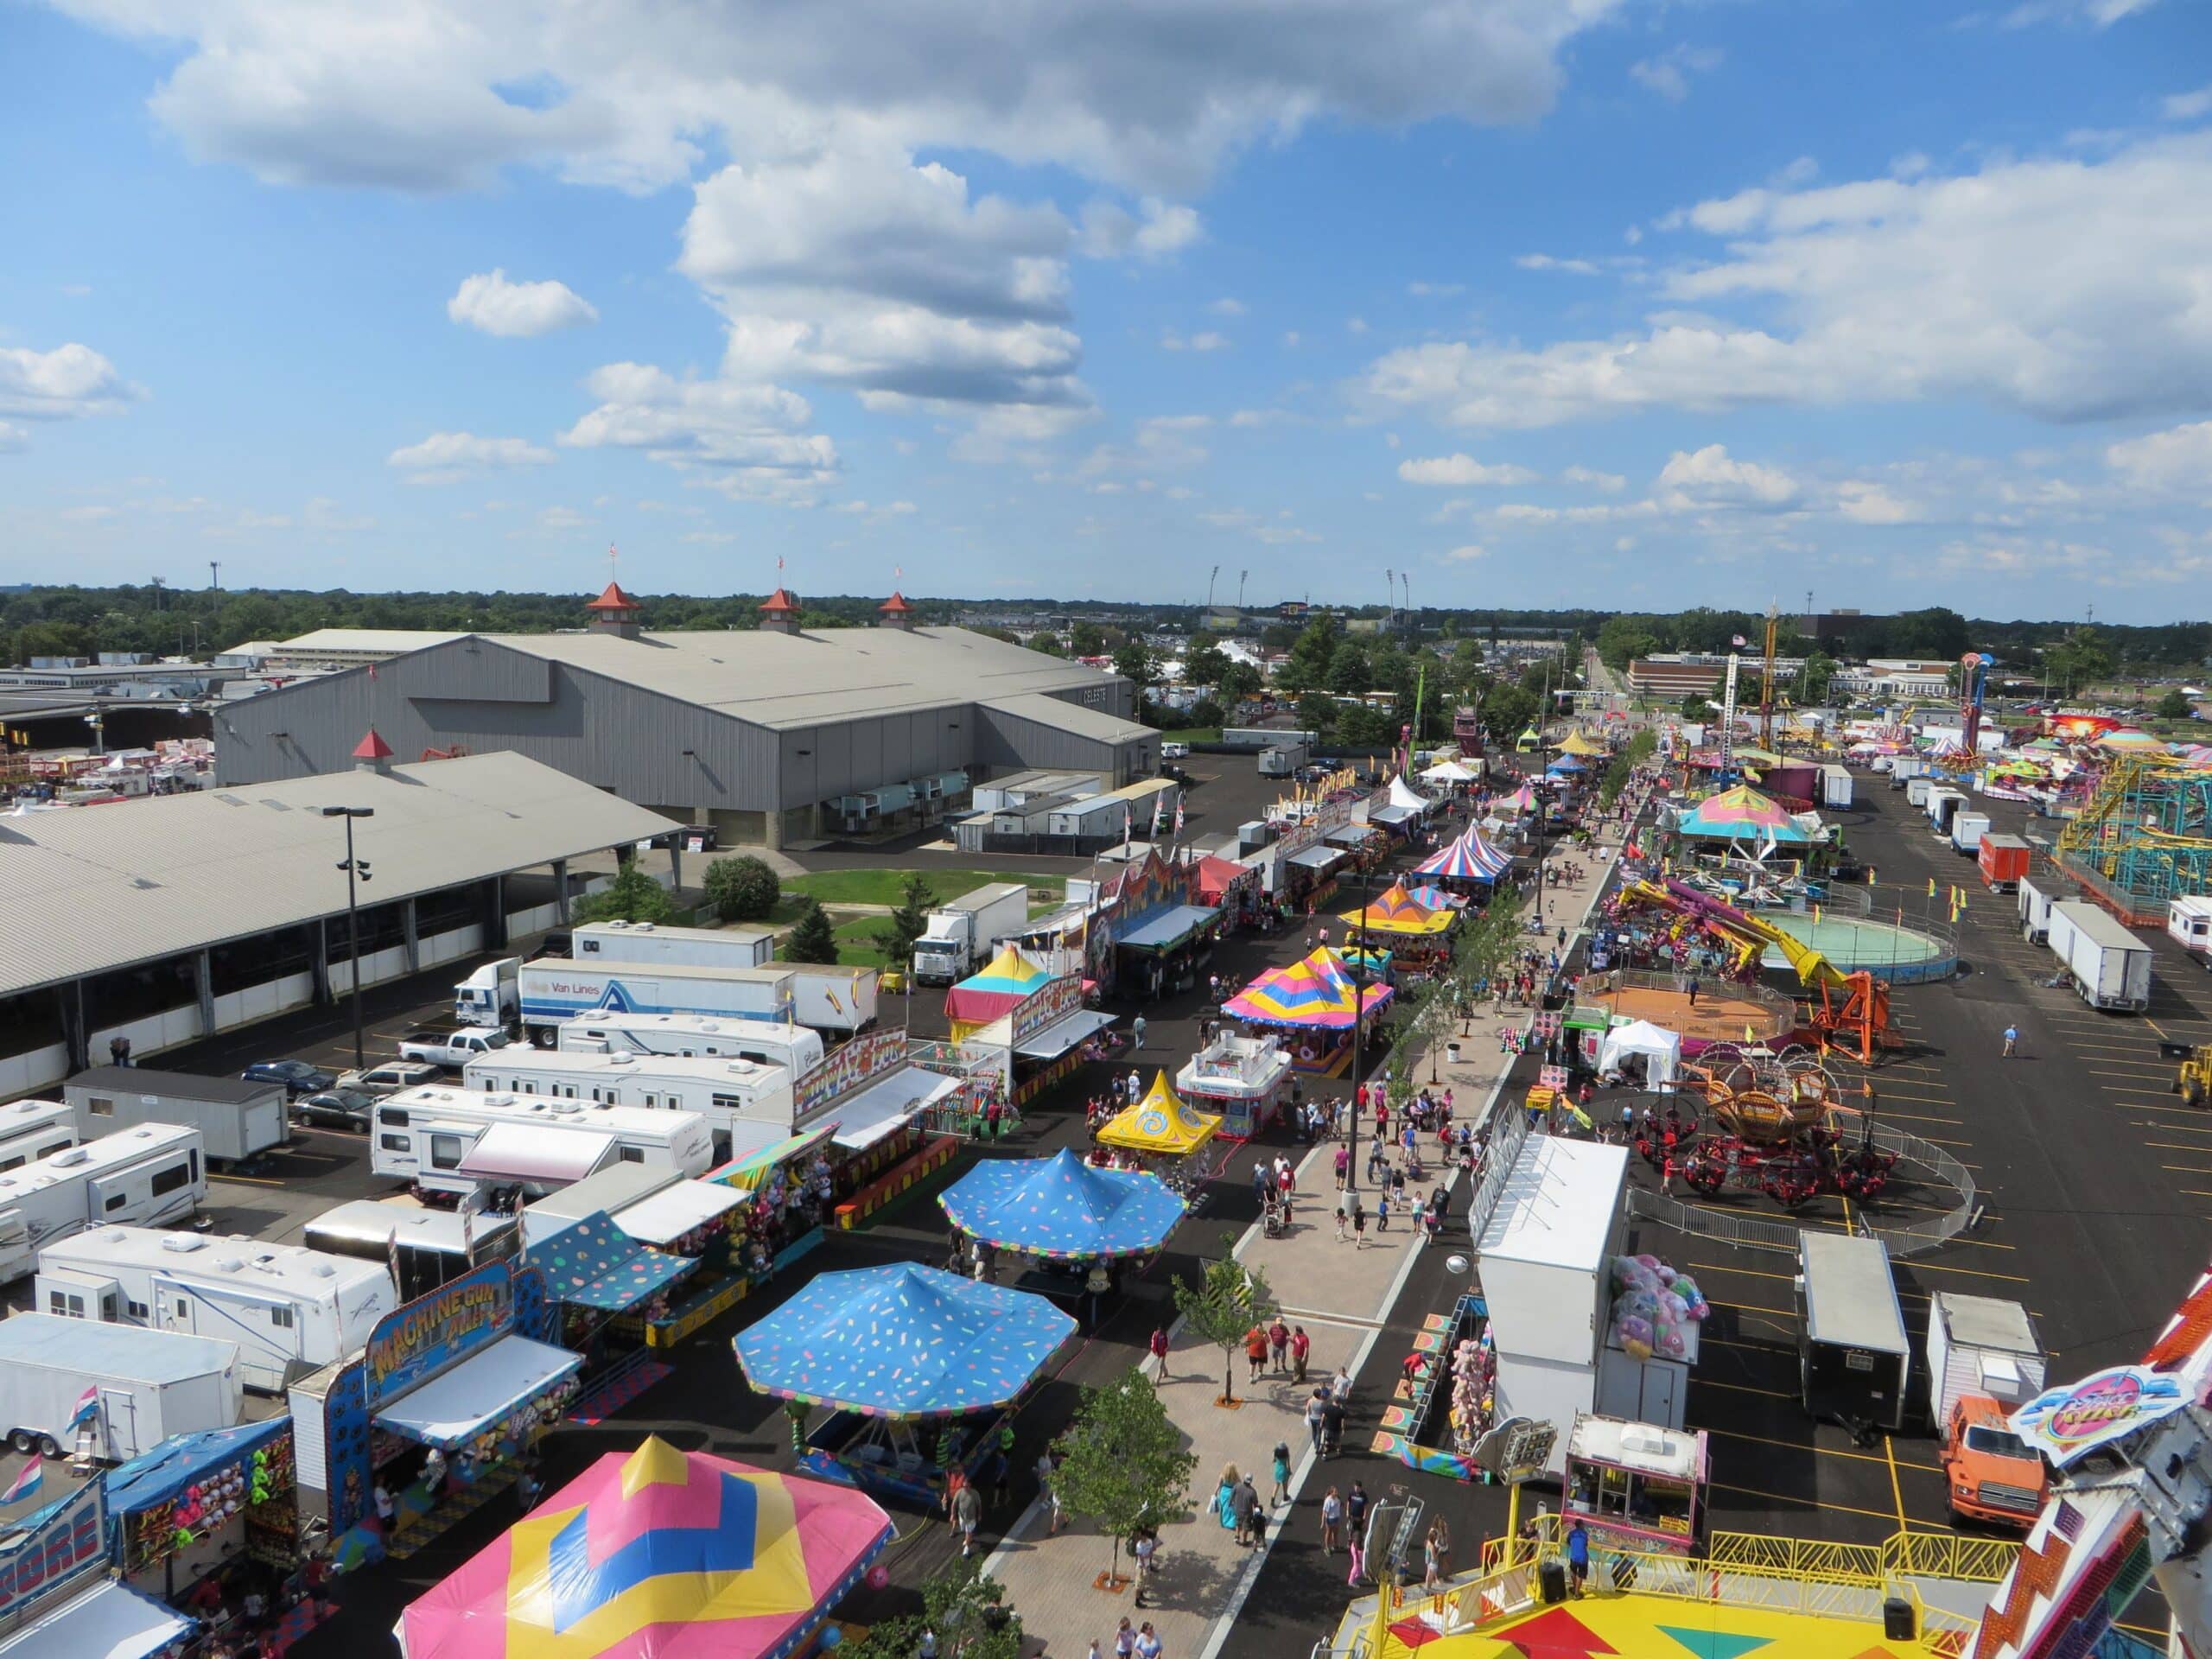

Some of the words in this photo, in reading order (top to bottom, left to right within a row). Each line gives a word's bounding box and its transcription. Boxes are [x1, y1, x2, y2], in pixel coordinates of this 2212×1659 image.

[1084, 687, 1106, 704] CELESTE
[552, 982, 570, 993] Van
[572, 982, 600, 995] Lines
[373, 1289, 461, 1383] MACHINE
[463, 1283, 494, 1307] GUN
[447, 1310, 486, 1342] ALLEY
